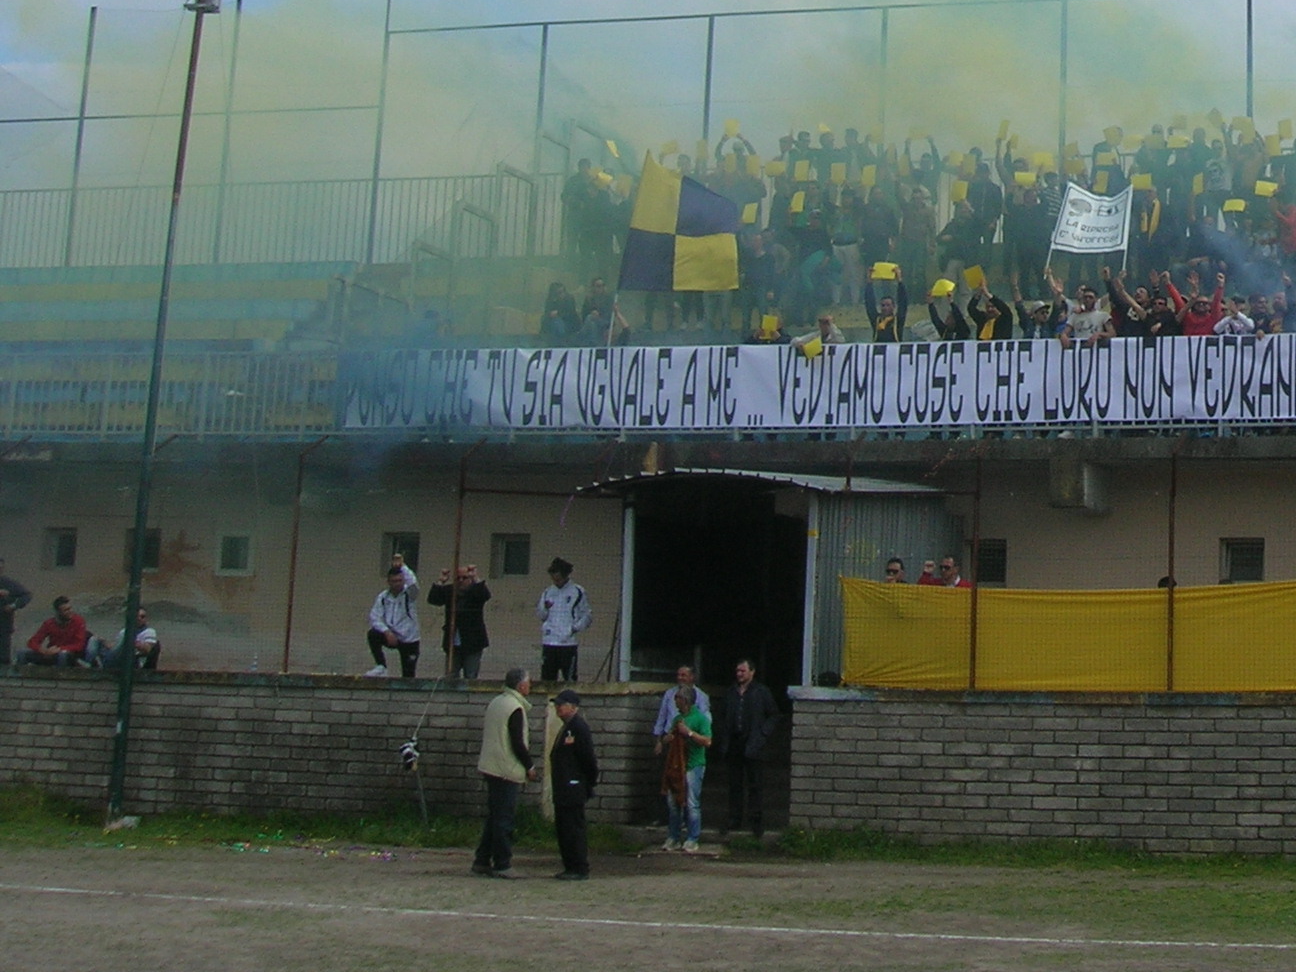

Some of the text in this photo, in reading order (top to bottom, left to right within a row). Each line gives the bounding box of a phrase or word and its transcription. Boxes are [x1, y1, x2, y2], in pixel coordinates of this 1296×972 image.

[425, 349, 478, 425] CHE
[522, 348, 569, 426] SIA
[680, 347, 698, 426] A
[778, 343, 887, 425] VEDIAMO
[896, 340, 965, 423] COSE
[975, 339, 1032, 421] CHE
[1043, 338, 1112, 420] LORO
[1123, 336, 1175, 419] NON
